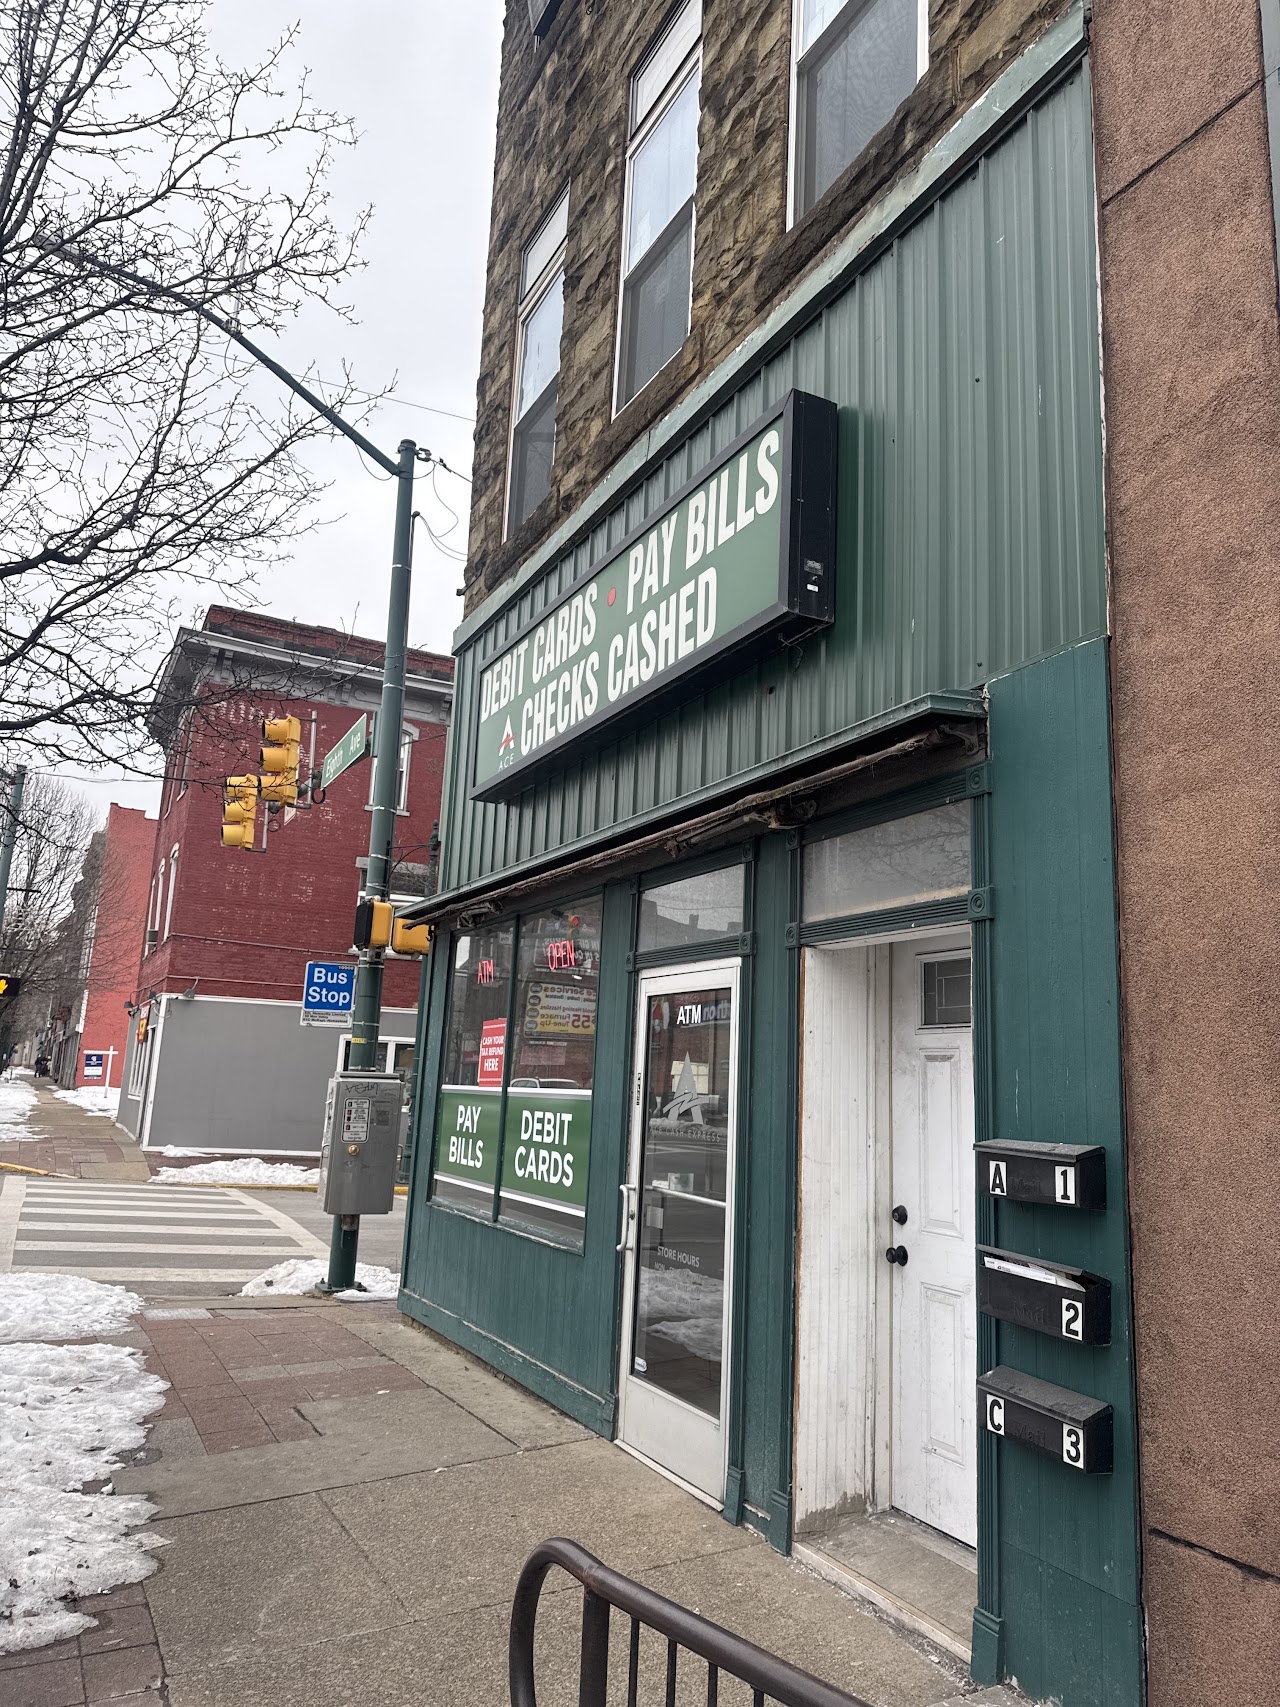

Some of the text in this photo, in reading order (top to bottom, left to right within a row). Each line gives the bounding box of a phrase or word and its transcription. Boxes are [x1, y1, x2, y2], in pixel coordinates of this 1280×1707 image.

[481, 430, 780, 724] DEBIT CARDS PAY BILLS
[520, 566, 717, 756] CHECKS CASHED
[326, 732, 361, 779] Eighth Ave
[498, 752, 514, 772] ACE
[548, 939, 576, 971] OPEN
[313, 967, 348, 985] Bus
[477, 959, 494, 984] ATM
[307, 986, 350, 1006] Stop
[676, 1004, 702, 1025] ATM
[482, 1035, 504, 1045] CASH YOUR
[489, 1047, 504, 1056] REFUND
[484, 1058, 499, 1071] HERE
[456, 1104, 481, 1134] PAY
[520, 1110, 573, 1146] DEBIT
[666, 1127, 684, 1137] CASH
[687, 1129, 721, 1142] EXPRESS
[449, 1136, 483, 1169] BILLS
[514, 1145, 574, 1187] CARDS
[990, 1163, 1006, 1194] A
[1060, 1168, 1071, 1201] 1
[657, 1245, 700, 1268] STORE HOURS
[1065, 1302, 1080, 1337] 2
[989, 1398, 1003, 1432] C
[1065, 1428, 1081, 1463] 3
